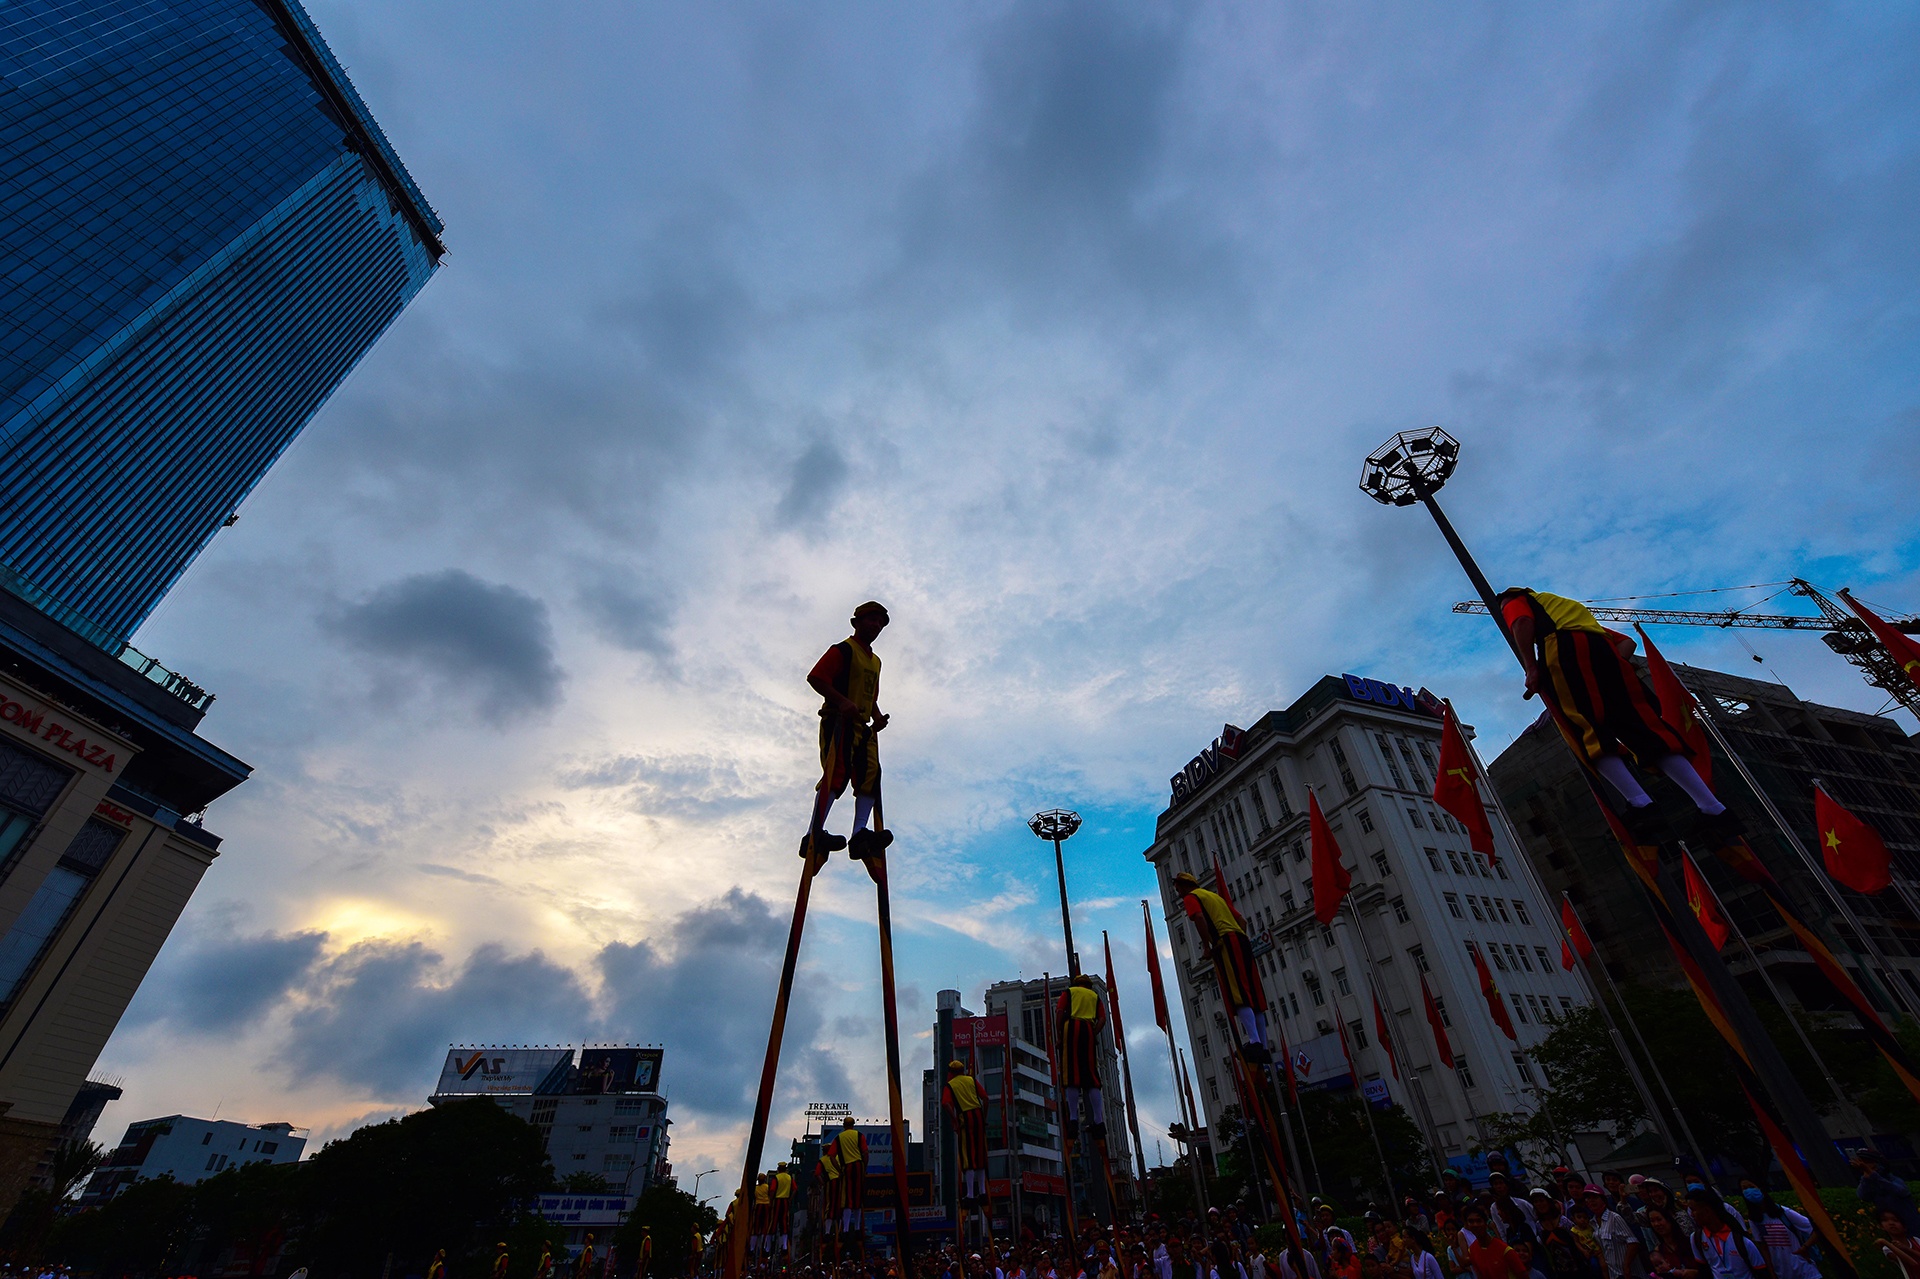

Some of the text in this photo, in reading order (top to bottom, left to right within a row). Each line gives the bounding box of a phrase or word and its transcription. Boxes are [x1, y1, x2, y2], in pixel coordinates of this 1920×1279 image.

[1342, 673, 1416, 712] BIDV
[42, 723, 116, 773] PLAZA
[1171, 738, 1221, 804] BIDV
[954, 1030, 1006, 1040] Hanha Life
[455, 1052, 505, 1081] VAS
